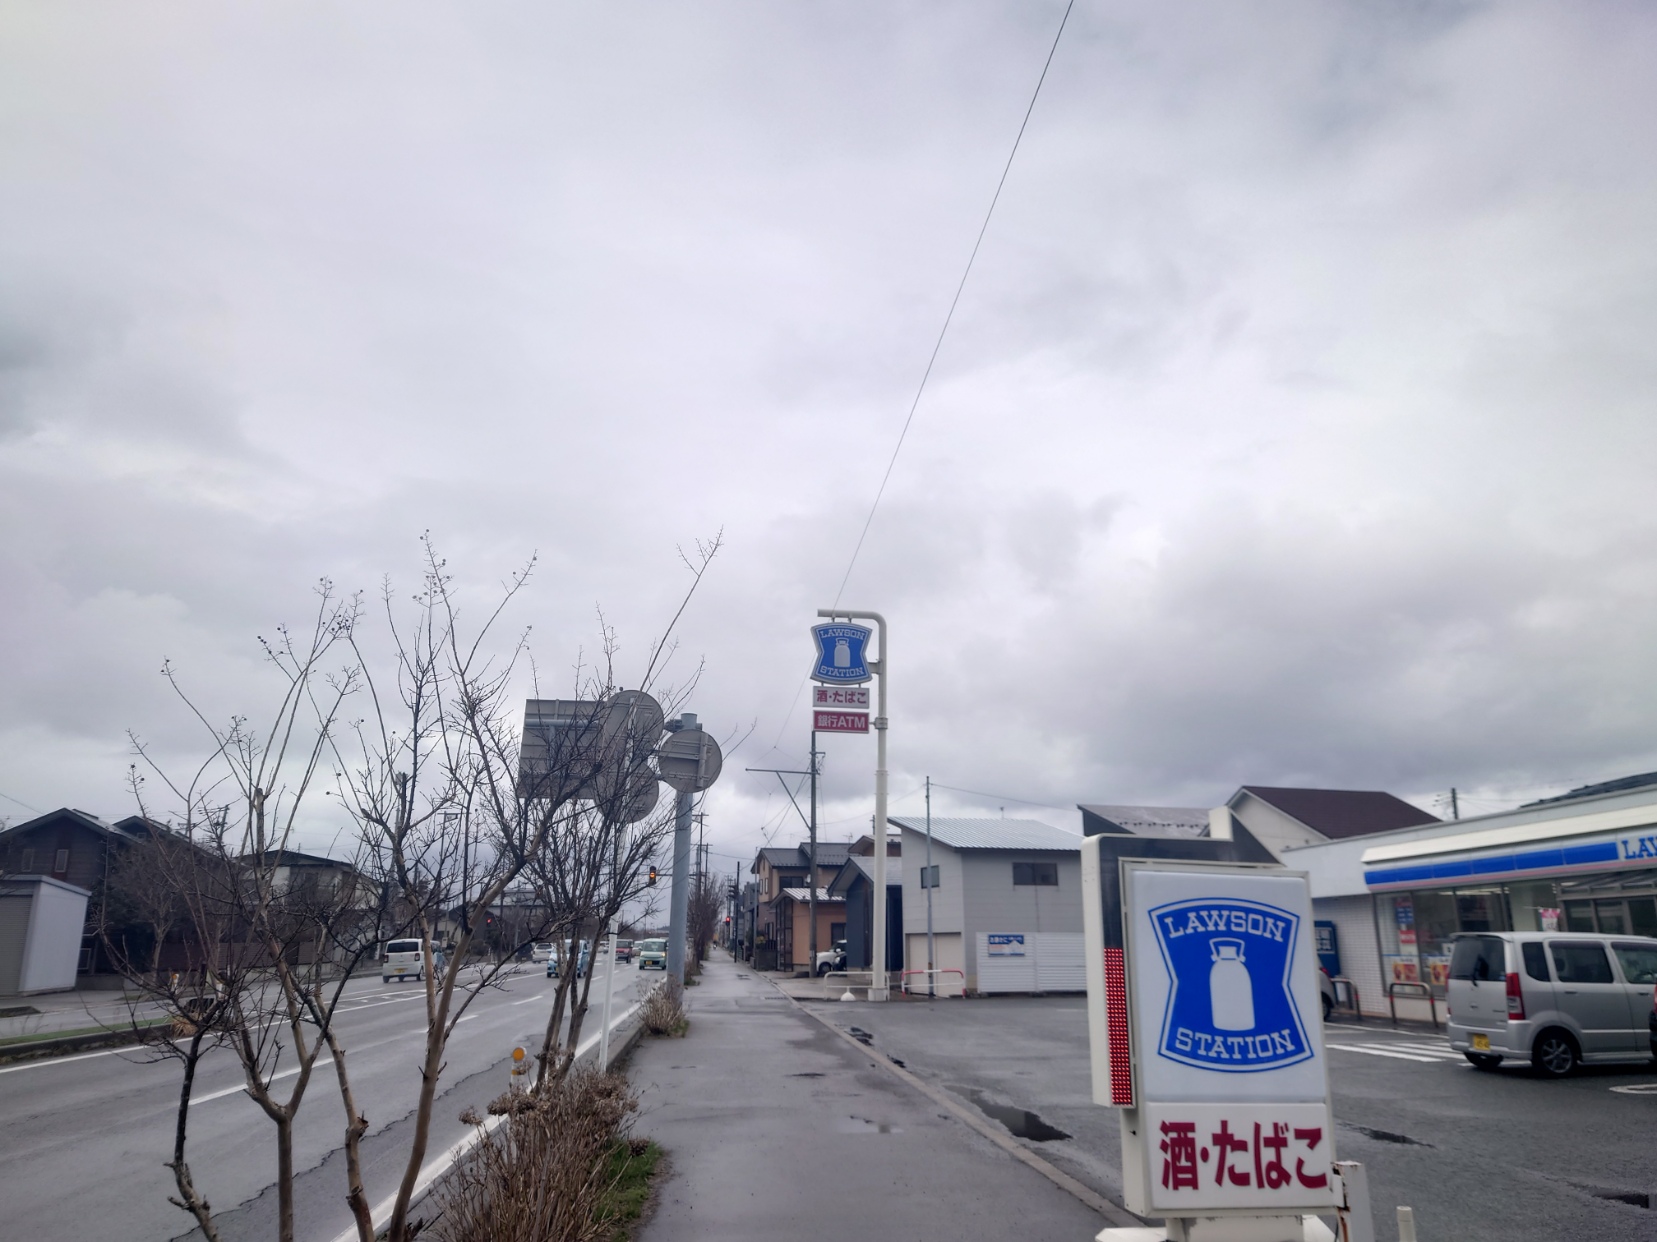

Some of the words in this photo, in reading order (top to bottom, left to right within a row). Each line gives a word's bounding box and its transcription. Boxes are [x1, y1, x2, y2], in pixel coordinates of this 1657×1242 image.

[820, 628, 865, 641] LAWSON
[820, 665, 864, 677] STATION
[817, 714, 866, 729] 銀行ATM
[1163, 909, 1286, 942] LAWSON
[1174, 1027, 1296, 1059] STATION
